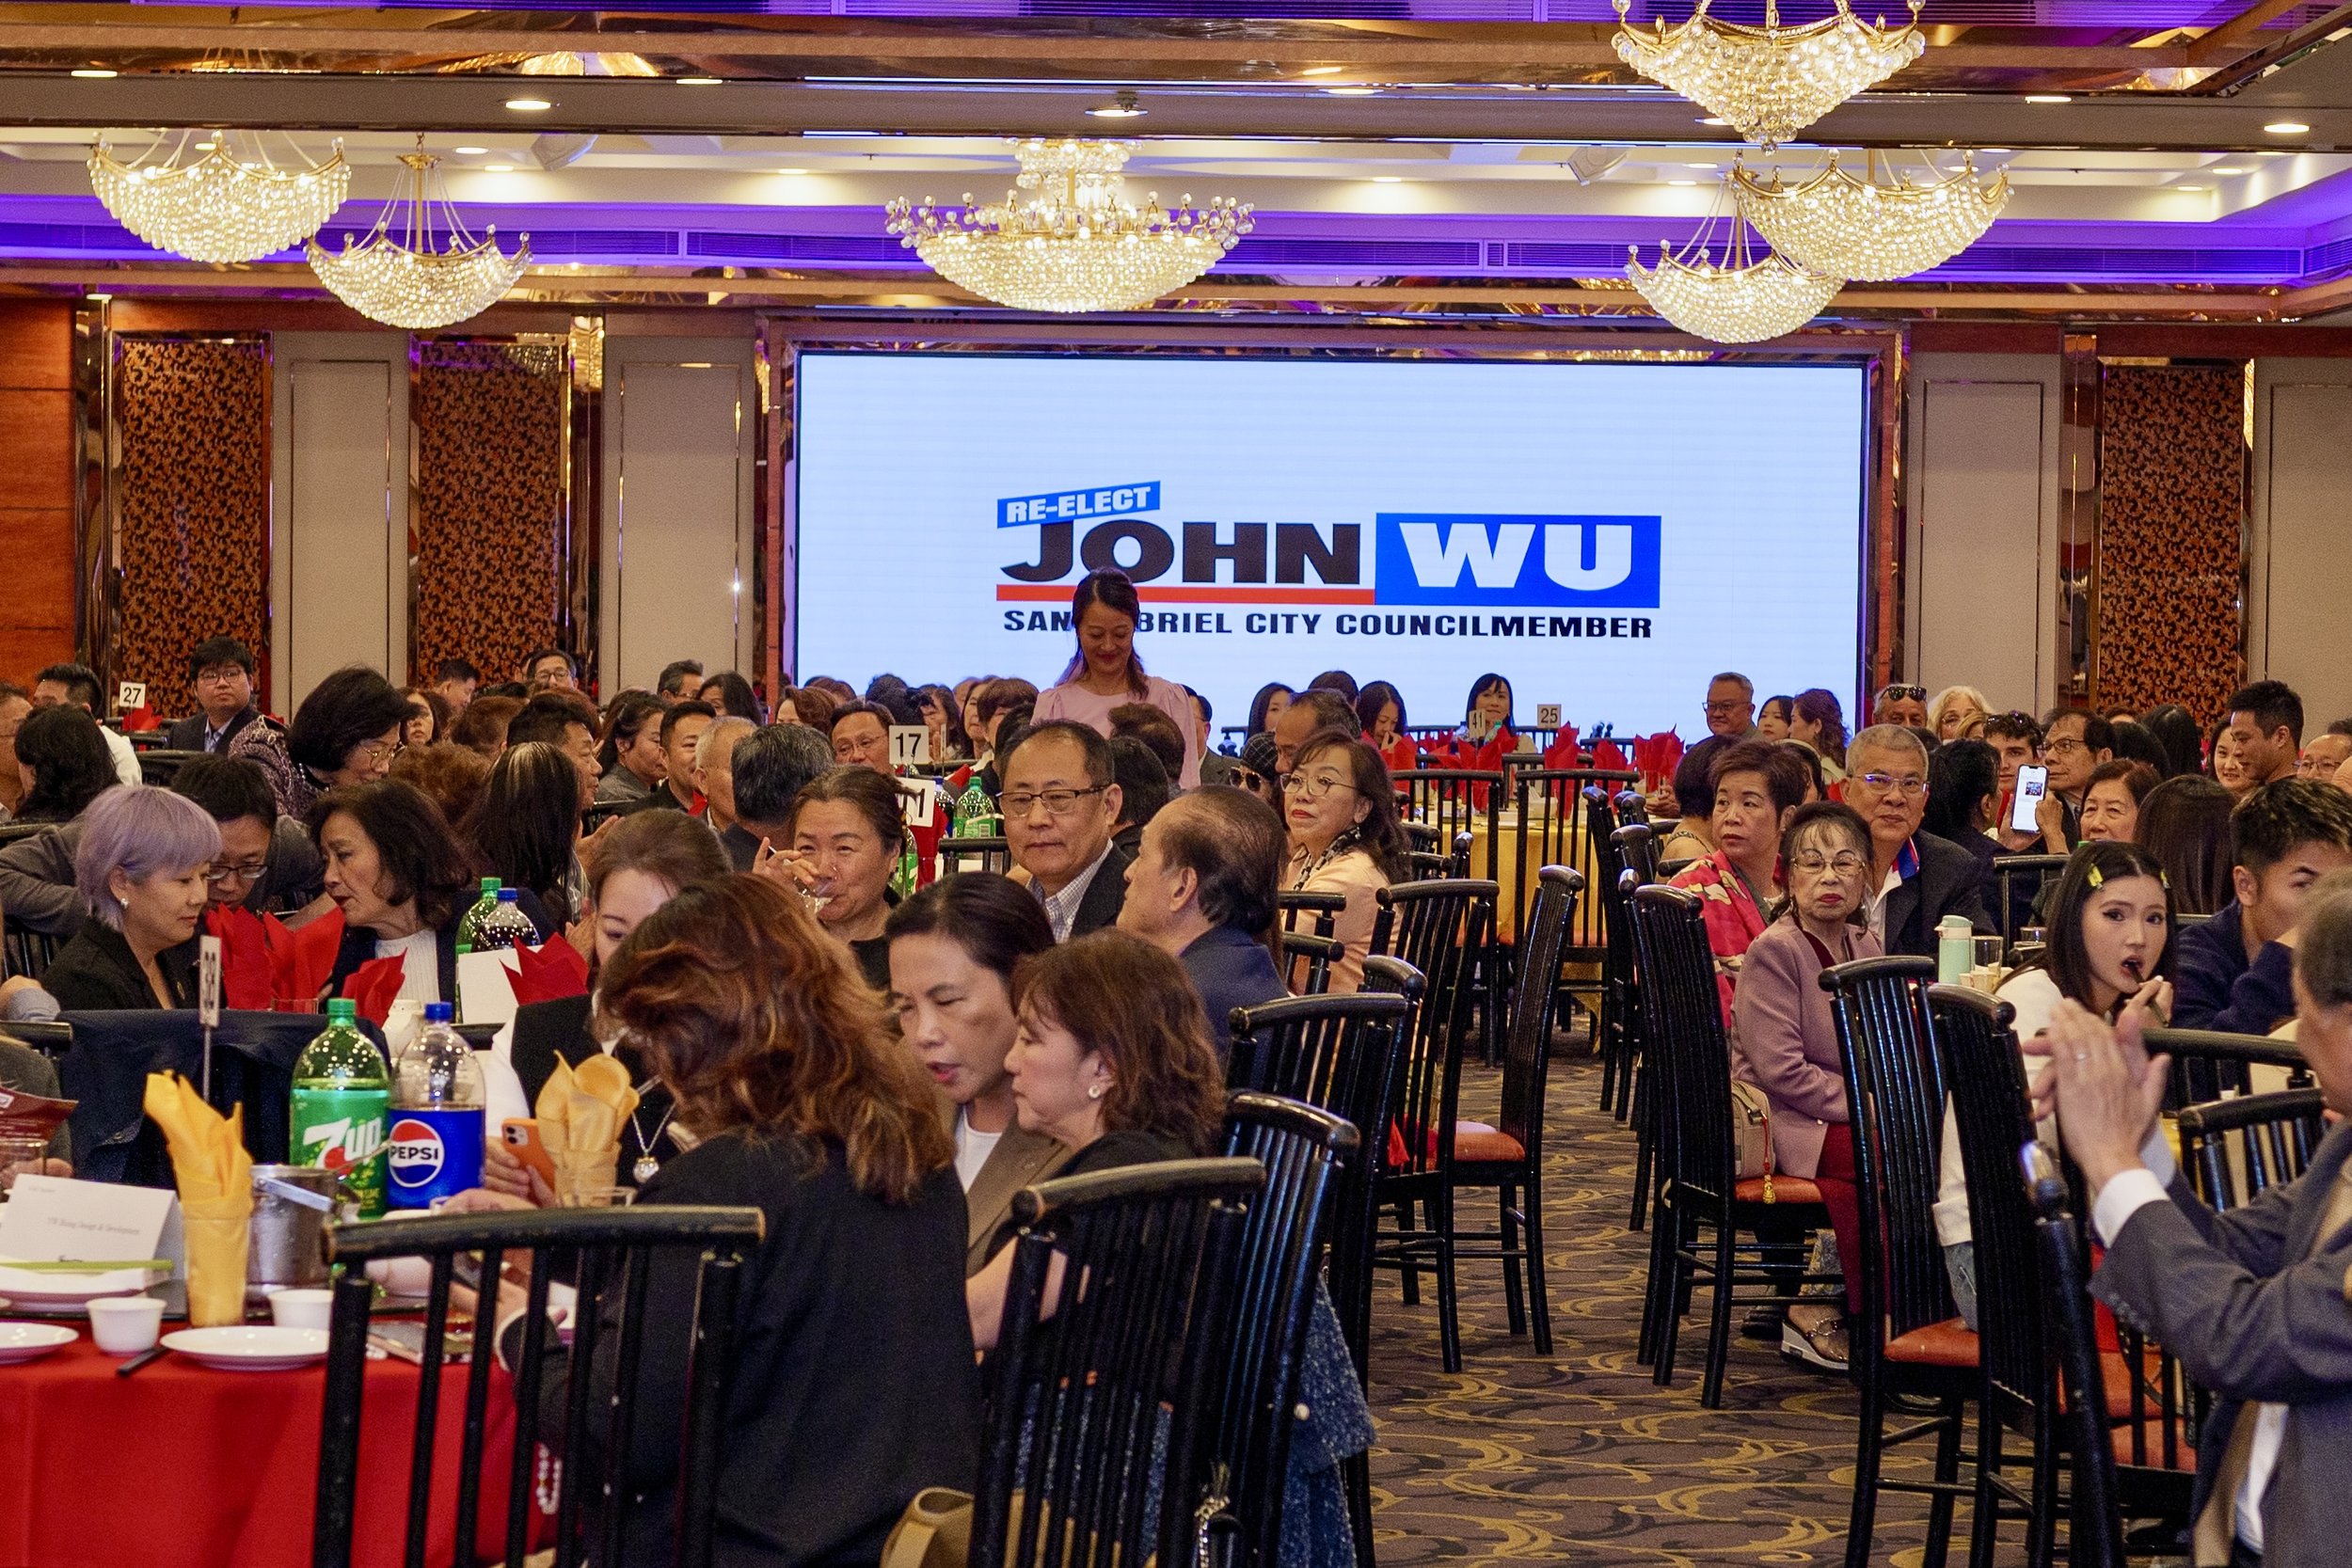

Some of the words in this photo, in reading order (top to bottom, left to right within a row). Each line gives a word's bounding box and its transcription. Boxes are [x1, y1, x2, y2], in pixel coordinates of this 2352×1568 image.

[1007, 486, 1151, 523] RE-ELECT
[1000, 519, 1360, 584] JOHN
[1399, 522, 1632, 591] WU
[1004, 610, 1072, 632] SAN
[1138, 612, 1232, 633] BRIEL
[1246, 613, 1322, 634] CITY
[1336, 614, 1652, 639] COUNCILMEMBER
[123, 687, 141, 704] 27
[1540, 707, 1558, 723] 25
[896, 733, 922, 757] 17
[389, 1146, 438, 1160] PEPSI
